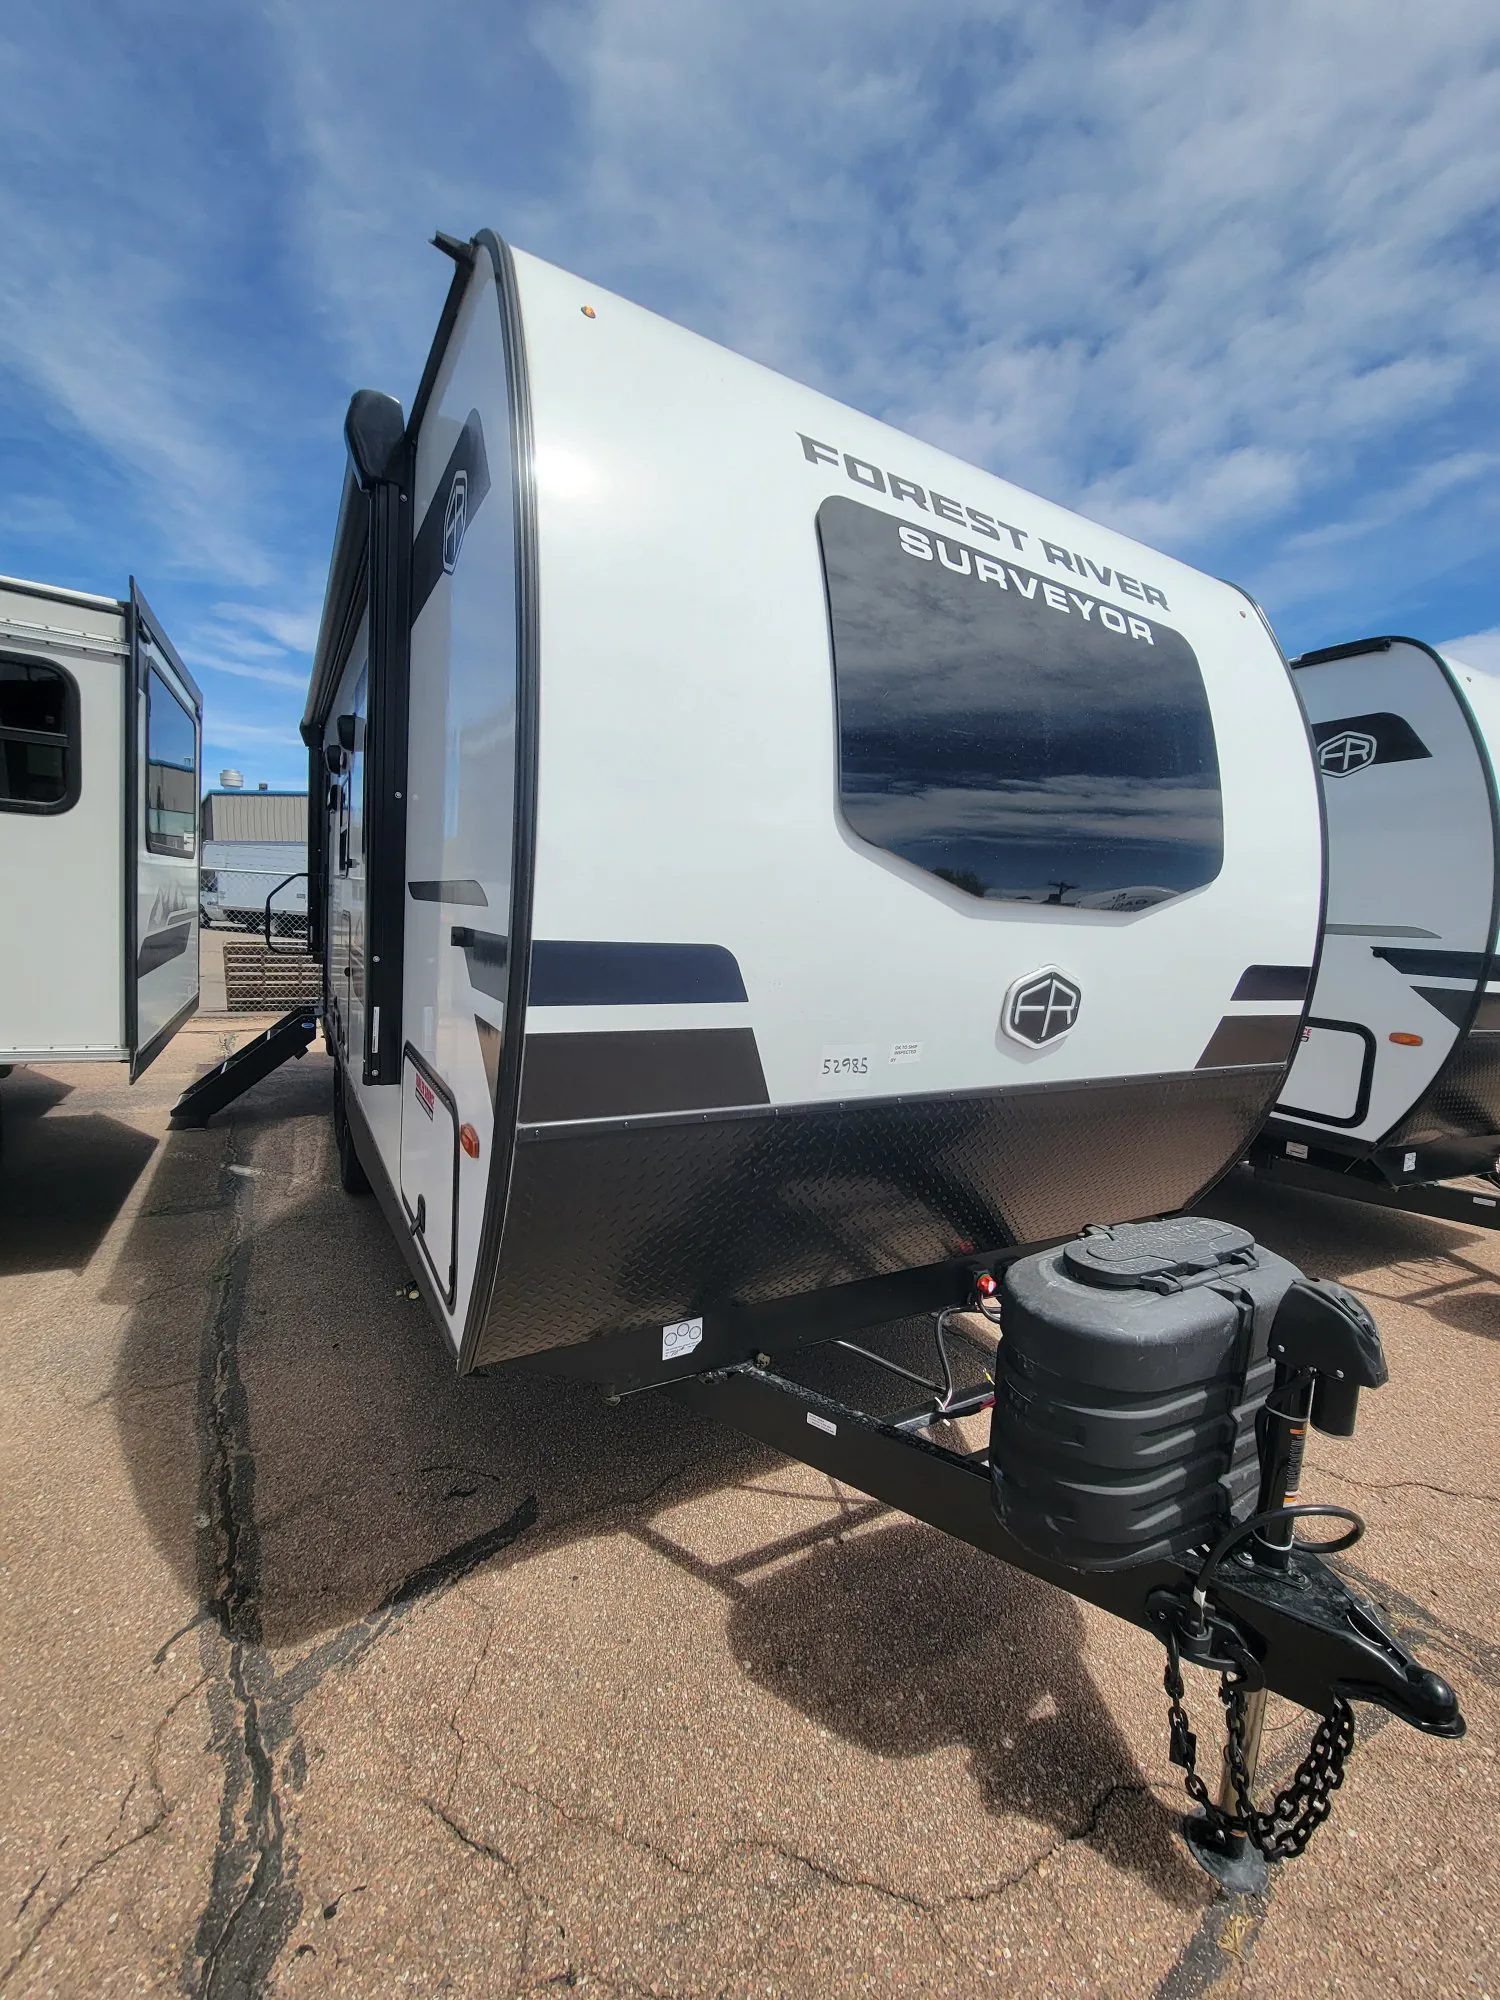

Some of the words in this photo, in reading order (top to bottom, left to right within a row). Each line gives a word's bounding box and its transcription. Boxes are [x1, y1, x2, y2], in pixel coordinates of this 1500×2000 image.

[795, 431, 1029, 552] FOREST
[1037, 537, 1172, 613] RIVER
[897, 525, 1155, 646] SURVEYOR
[822, 1057, 868, 1075] 52985
